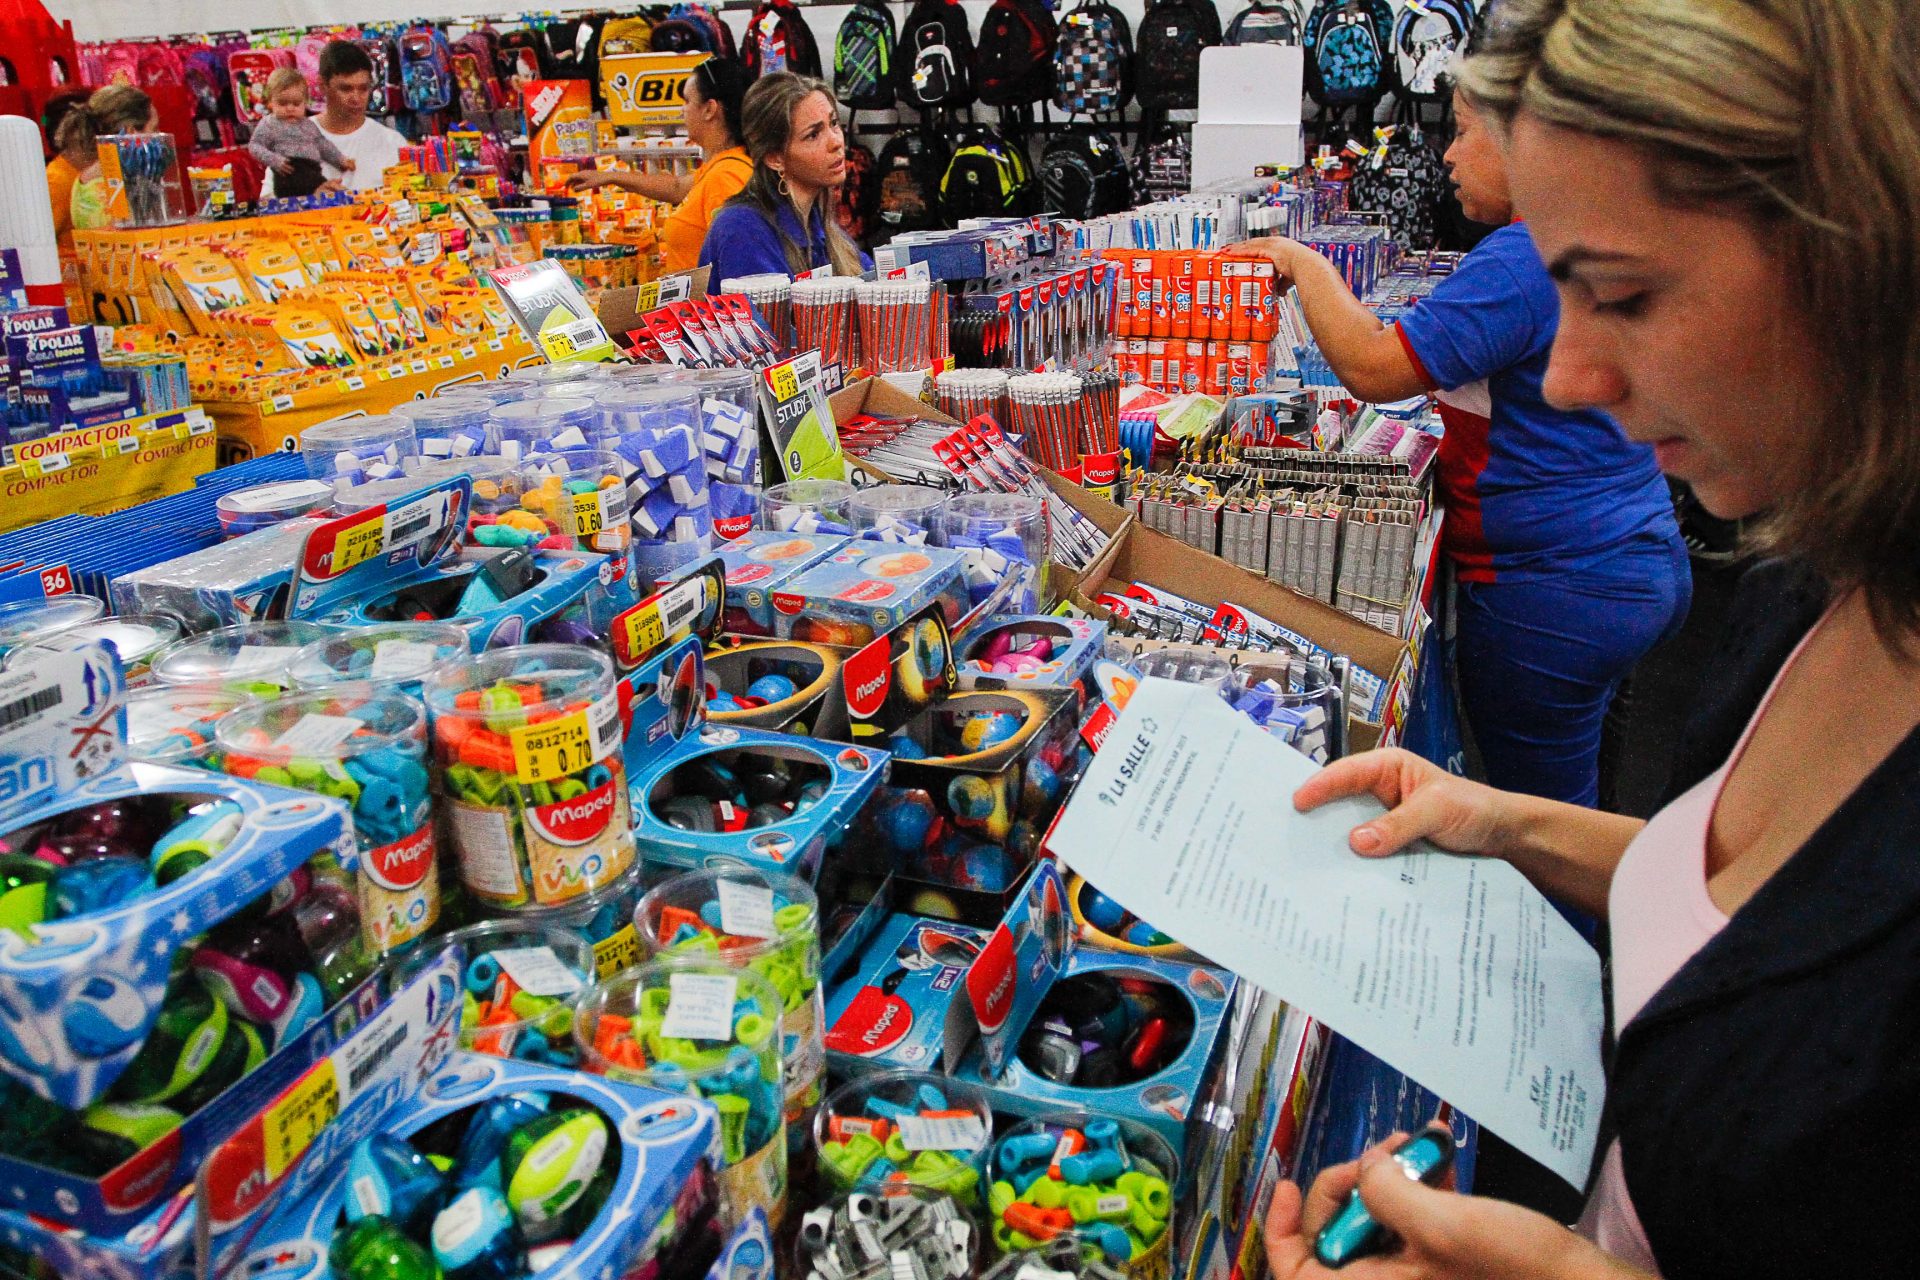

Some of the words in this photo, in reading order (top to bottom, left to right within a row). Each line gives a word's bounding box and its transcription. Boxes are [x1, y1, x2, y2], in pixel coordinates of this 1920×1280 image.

[13, 317, 56, 332] POLAR
[39, 334, 83, 350] POLAR
[777, 394, 807, 424] STUDY
[20, 423, 131, 461] COMPACTOR
[134, 436, 215, 465] COMPACTOR
[6, 464, 99, 497] COMPACTOR
[1089, 468, 1115, 478] Maped
[719, 519, 750, 533] Maped
[44, 573, 66, 593] 36
[776, 596, 802, 608] Maped
[855, 671, 887, 701] Maped
[525, 727, 584, 751] 0812714
[557, 740, 592, 773] 0.70
[1110, 778, 1128, 797] LA
[1120, 734, 1151, 779] SALLE
[550, 790, 614, 827] Maped
[985, 964, 1013, 1015] Maped
[861, 1003, 899, 1046] Maped
